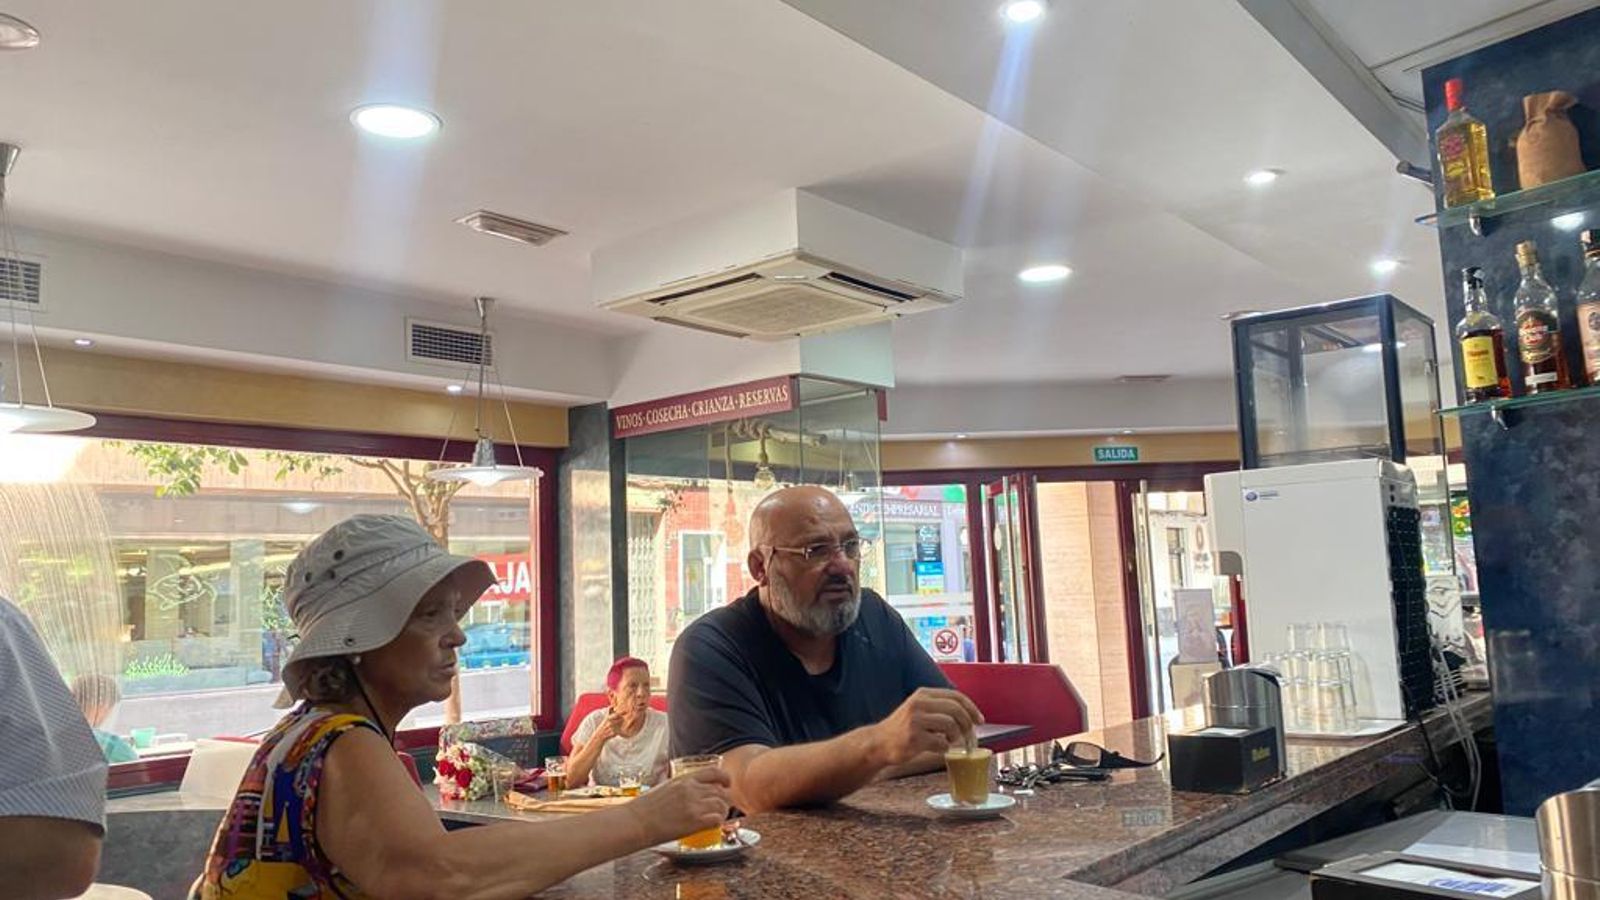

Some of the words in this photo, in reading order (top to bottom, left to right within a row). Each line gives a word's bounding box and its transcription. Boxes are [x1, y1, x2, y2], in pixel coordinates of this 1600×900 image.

[616, 411, 643, 430] VINOS
[645, 405, 688, 425] COSECHA
[691, 396, 735, 417] CRIANZA
[739, 384, 788, 409] RESERVAS
[1097, 448, 1136, 460] SALIDA
